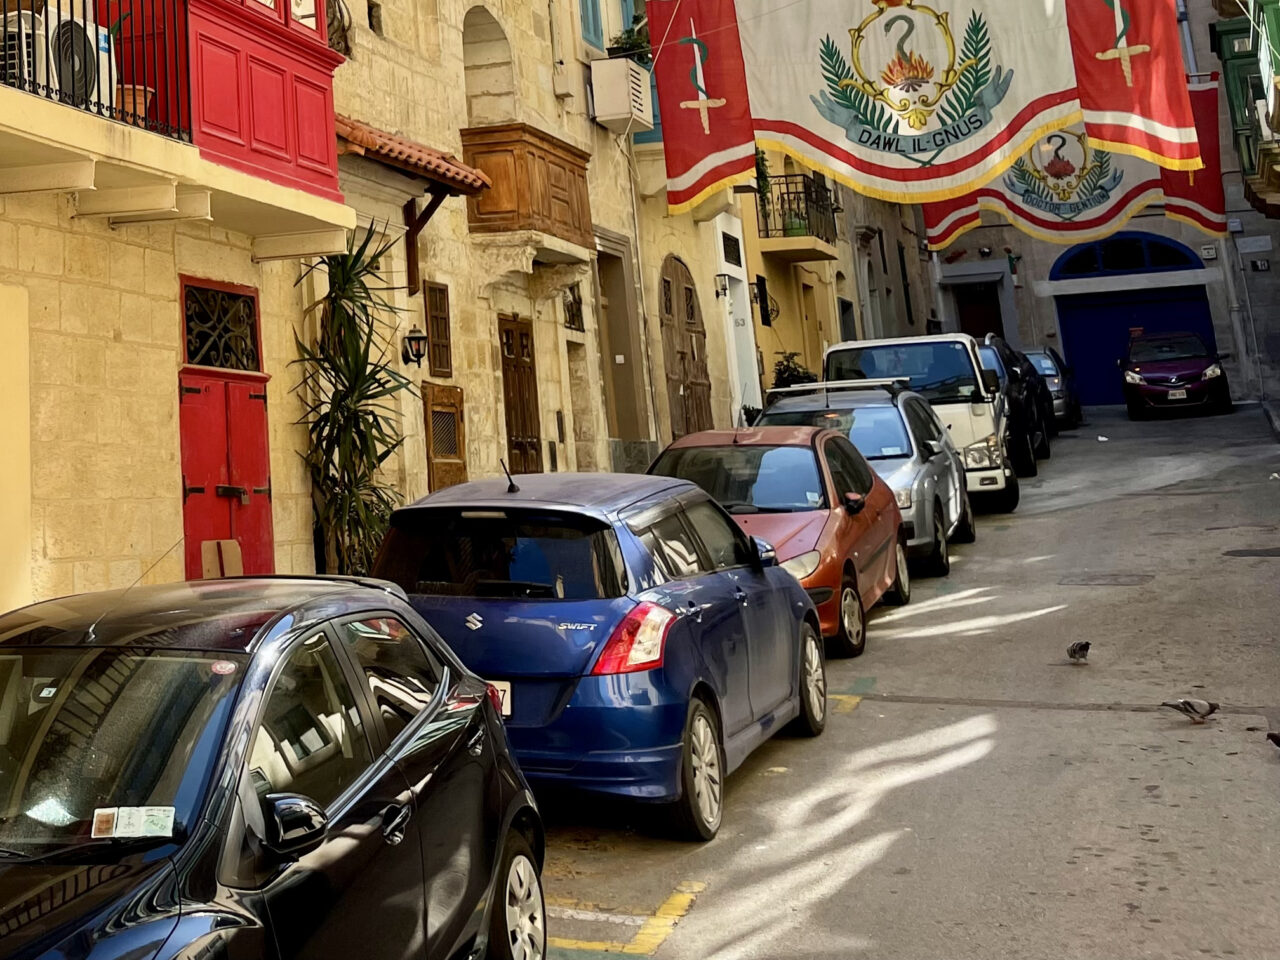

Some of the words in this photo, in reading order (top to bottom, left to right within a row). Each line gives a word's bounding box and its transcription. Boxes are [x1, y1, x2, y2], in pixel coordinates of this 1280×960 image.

[858, 129, 905, 152] DAWL
[913, 113, 983, 152] IL-GNUS
[1025, 194, 1061, 212] DOCTOR
[558, 622, 598, 631] SWIFT
